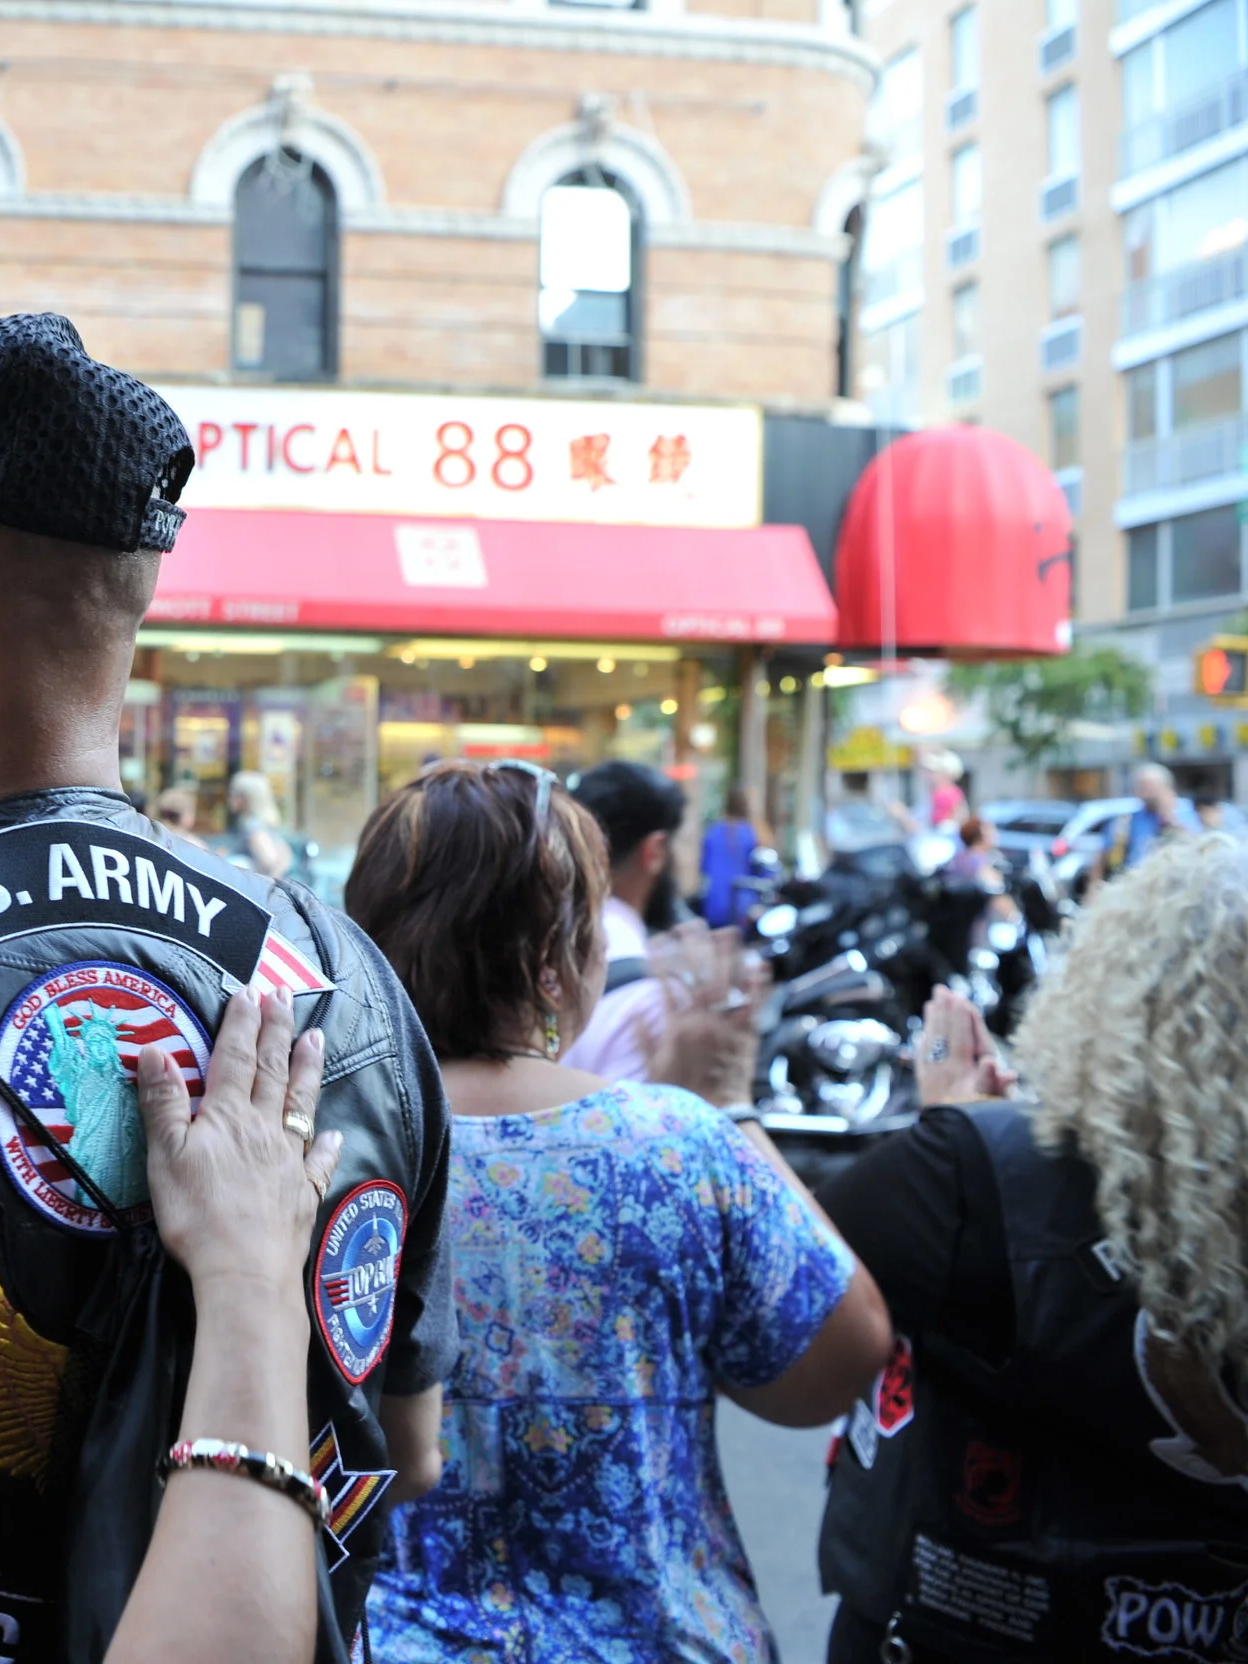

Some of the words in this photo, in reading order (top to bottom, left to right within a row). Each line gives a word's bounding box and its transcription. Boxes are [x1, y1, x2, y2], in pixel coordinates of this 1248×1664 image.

[197, 420, 392, 477] PTICAL
[431, 420, 535, 492] 88
[49, 843, 227, 937] ARMY
[12, 994, 42, 1030] GOD
[43, 970, 98, 998] BLESS
[102, 971, 176, 1018] AMERICA
[6, 1136, 35, 1184] WITH
[33, 1181, 99, 1227] LIBERTY
[326, 1203, 358, 1257] UNITED
[360, 1191, 396, 1210] STATES
[1115, 1593, 1224, 1648] POW
